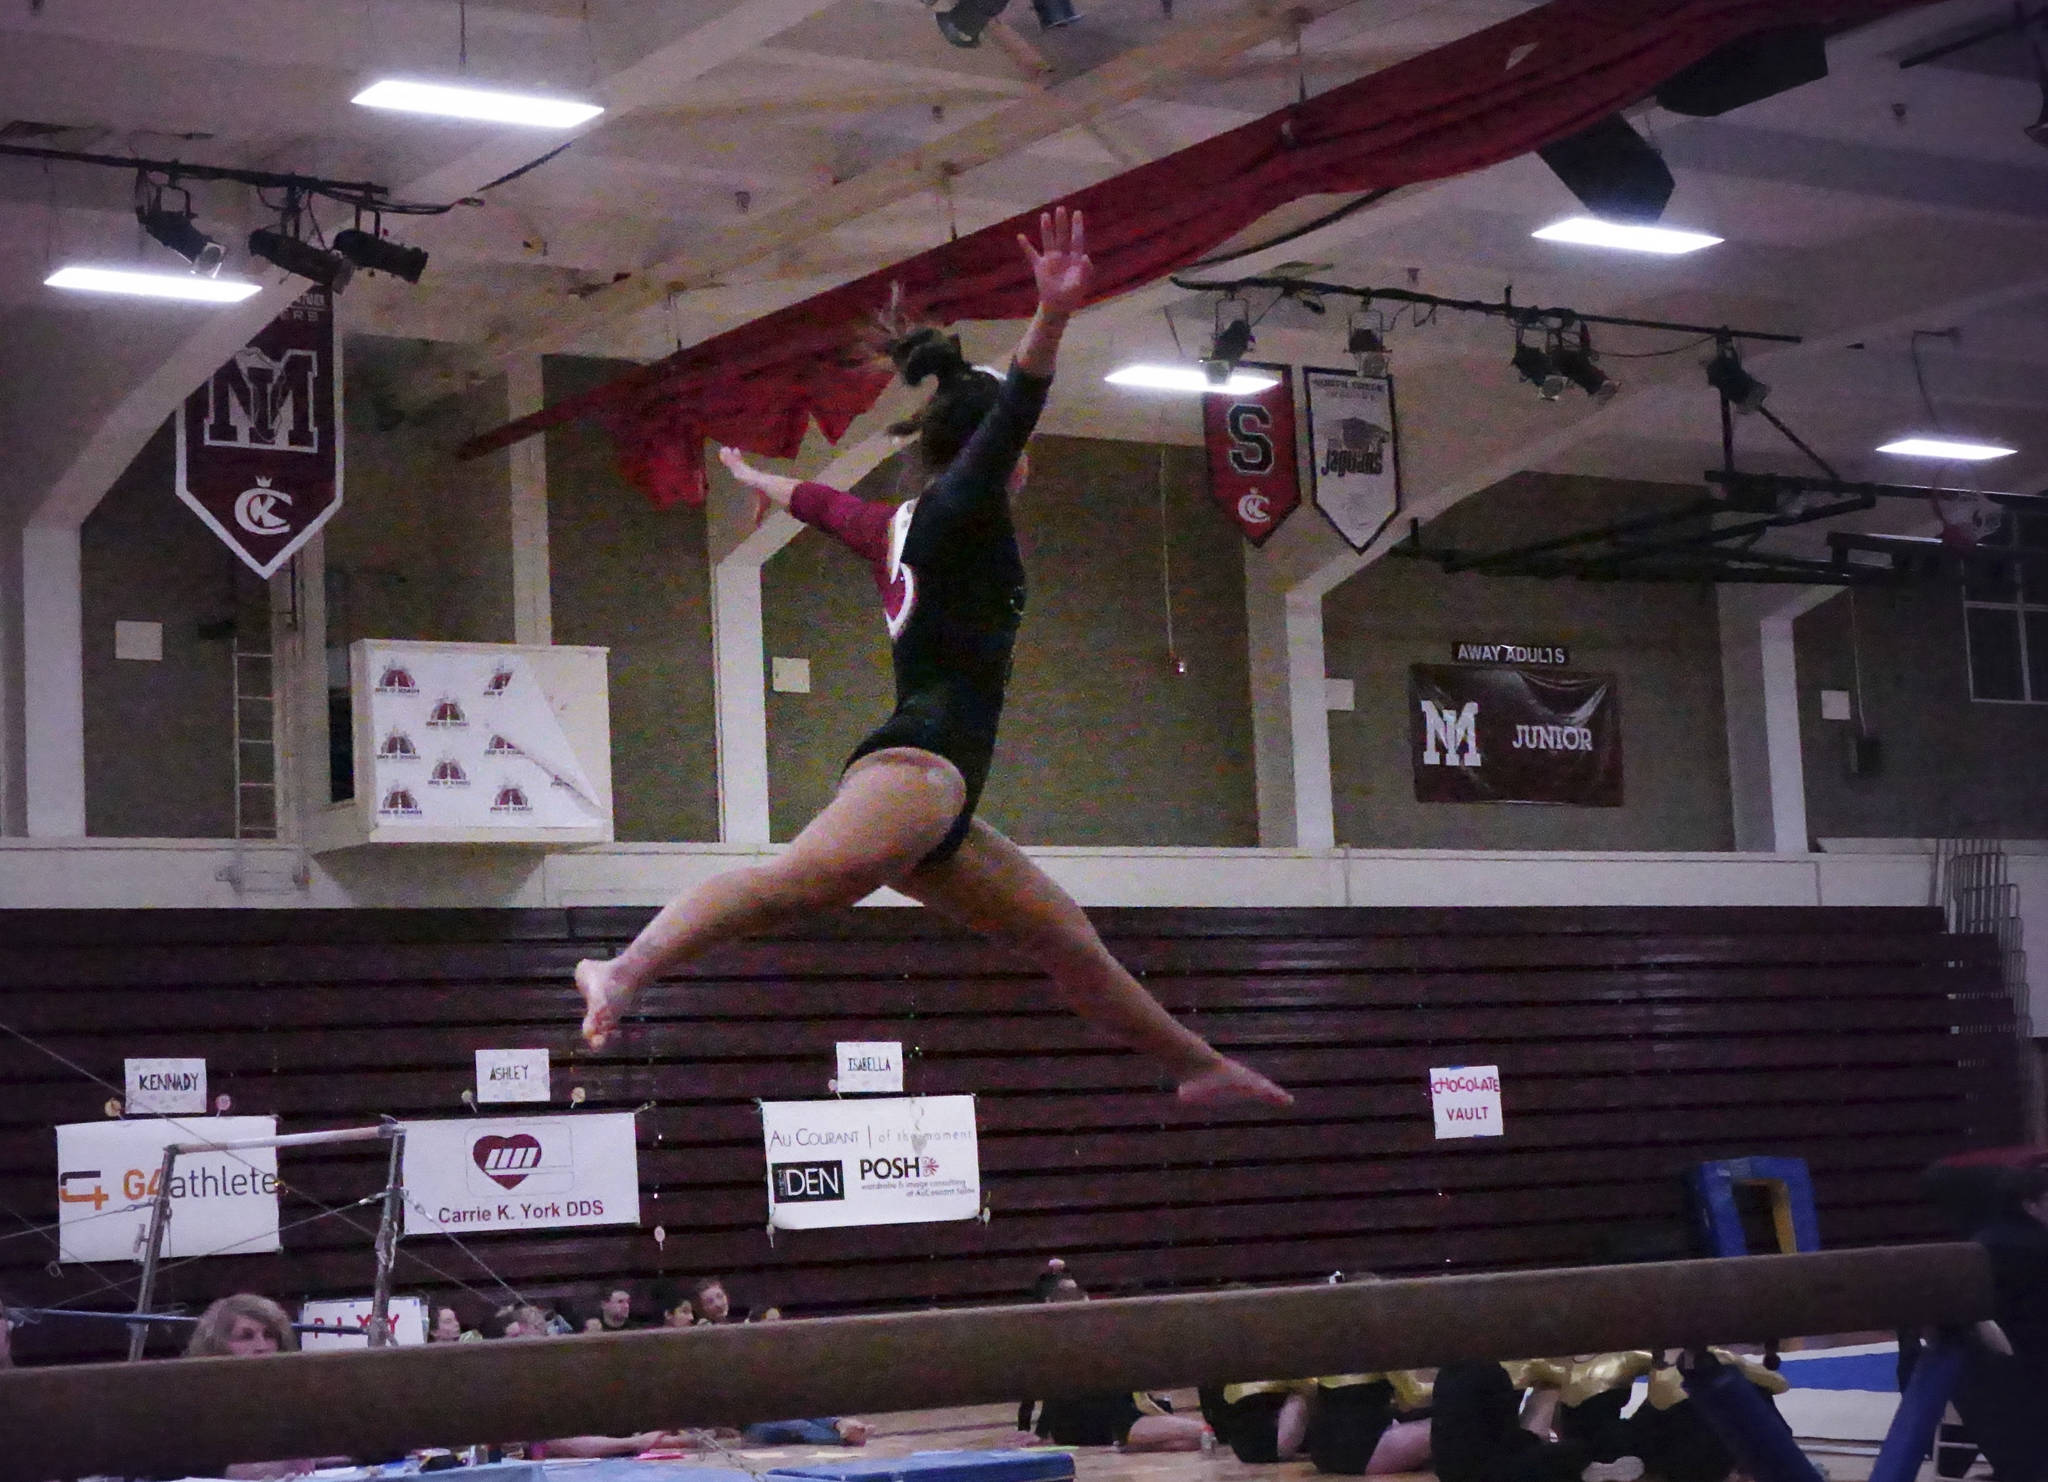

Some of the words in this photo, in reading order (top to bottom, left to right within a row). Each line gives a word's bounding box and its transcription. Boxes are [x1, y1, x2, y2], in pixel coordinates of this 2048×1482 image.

[1227, 403, 1274, 475] S
[1457, 644, 1502, 661] AWAY
[1505, 646, 1565, 664] ADULTS
[1512, 724, 1593, 751] JUNIOR
[489, 1065, 529, 1081] ASHLEY
[847, 1056, 892, 1072] ISABELLA
[138, 1072, 199, 1091] KENNADY
[1432, 1076, 1502, 1094] CHOCOLATE
[1446, 1106, 1489, 1121] VAULT
[878, 1128, 891, 1143] of
[924, 1130, 973, 1142] moment
[859, 1156, 921, 1181] POSH
[786, 1167, 839, 1196] DEN
[438, 1207, 493, 1224] Carrie
[497, 1205, 516, 1222] K.
[520, 1202, 560, 1219] York
[566, 1200, 604, 1217] DDS
